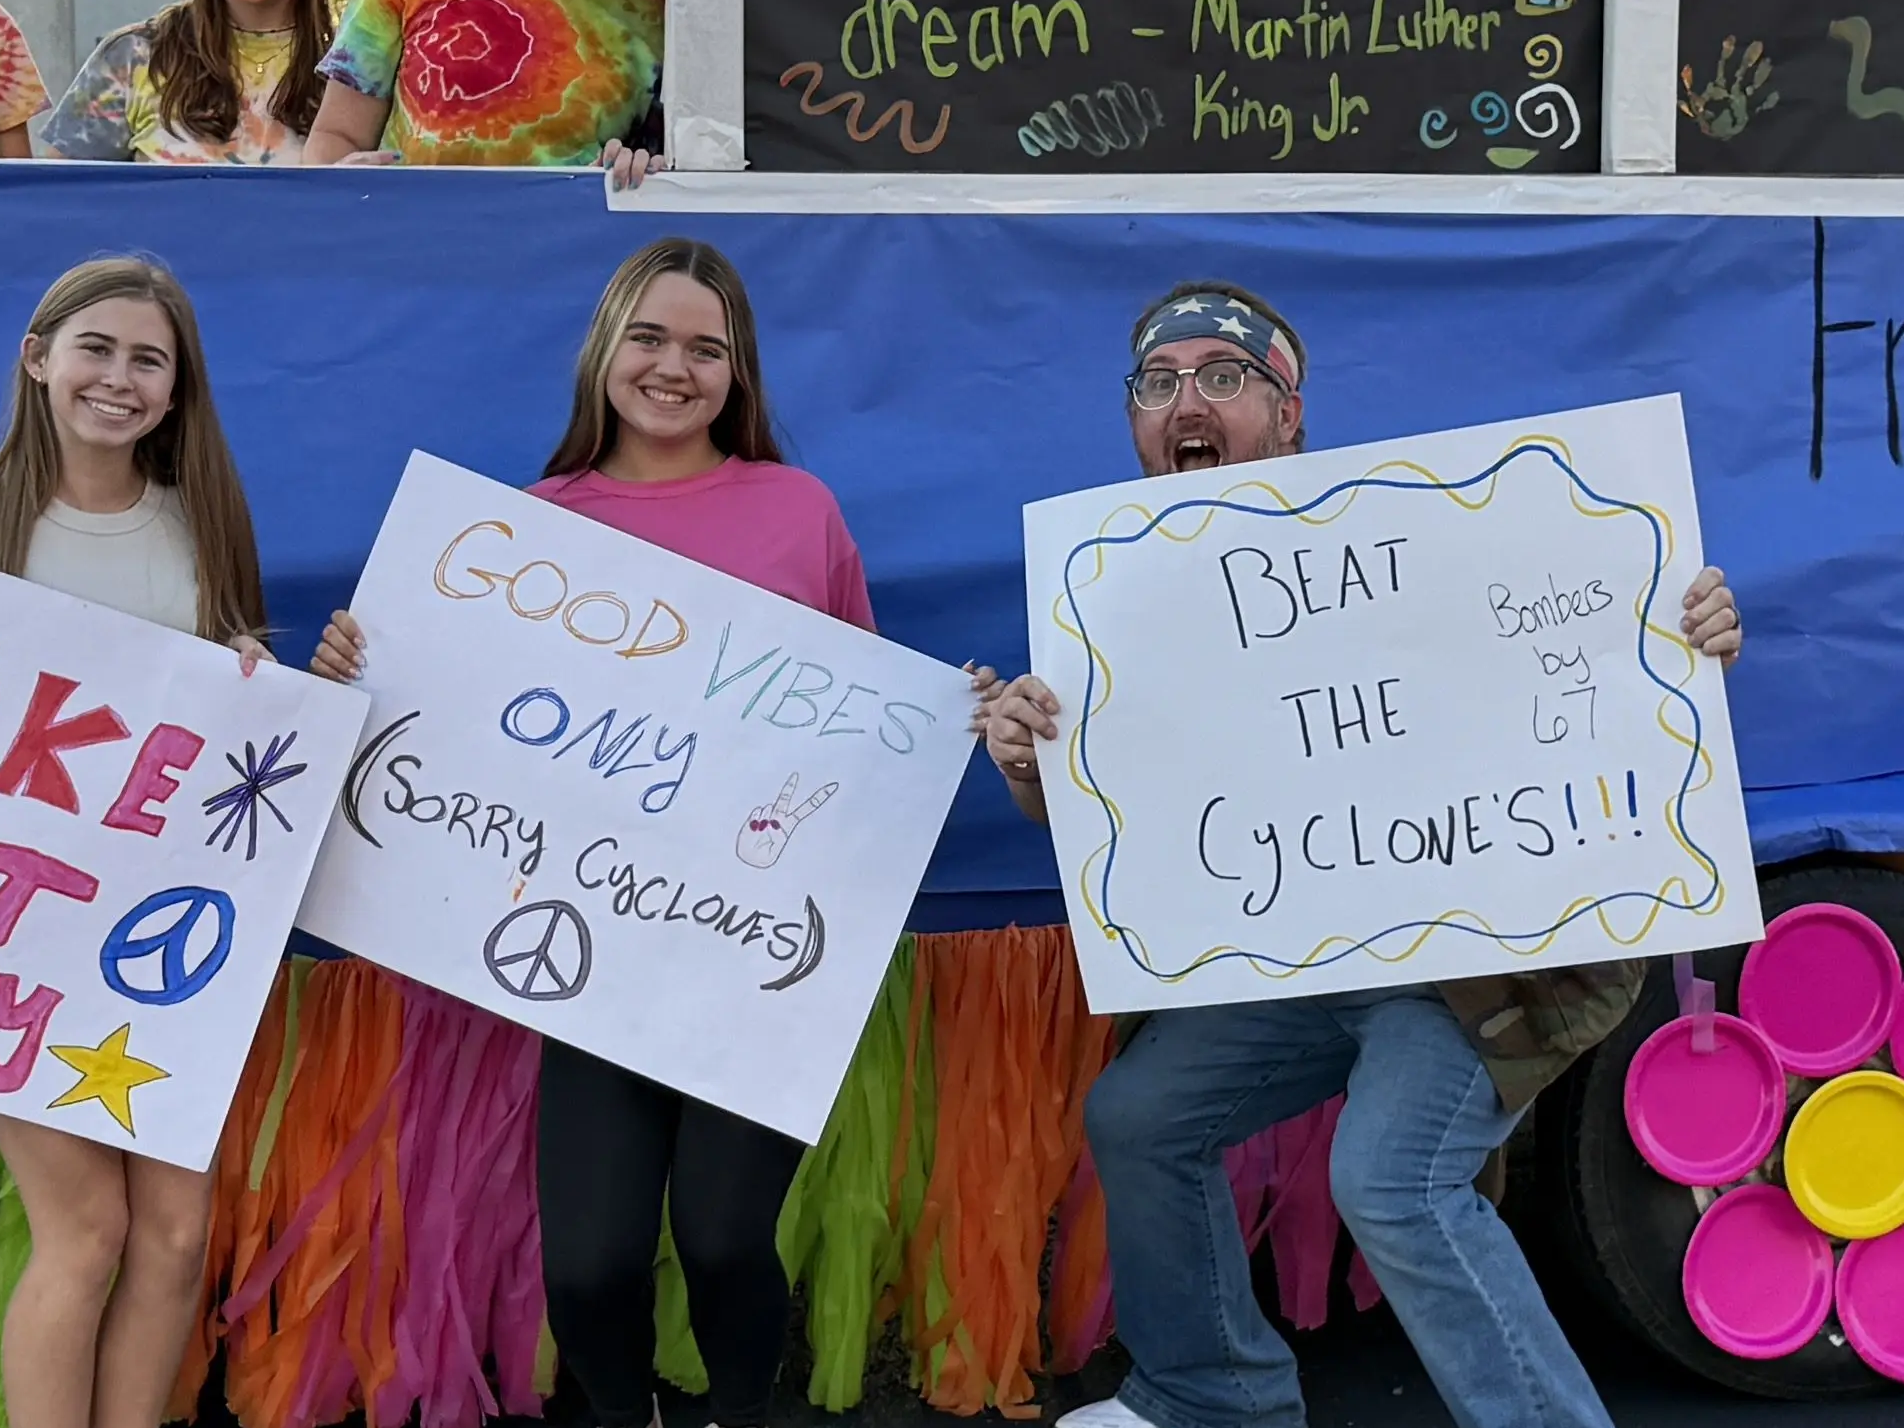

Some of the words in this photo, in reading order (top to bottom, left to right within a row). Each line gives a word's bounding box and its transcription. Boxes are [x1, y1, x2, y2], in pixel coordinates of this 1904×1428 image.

[1193, 69, 1293, 161] King
[1312, 71, 1371, 143] Jr.
[1219, 538, 1408, 649] BEAT
[1486, 573, 1613, 638] Bombers
[433, 520, 689, 660] GOOD
[703, 620, 937, 755] VIBES
[1535, 645, 1591, 684] by
[1281, 678, 1407, 758] THE
[1532, 686, 1598, 744] 67
